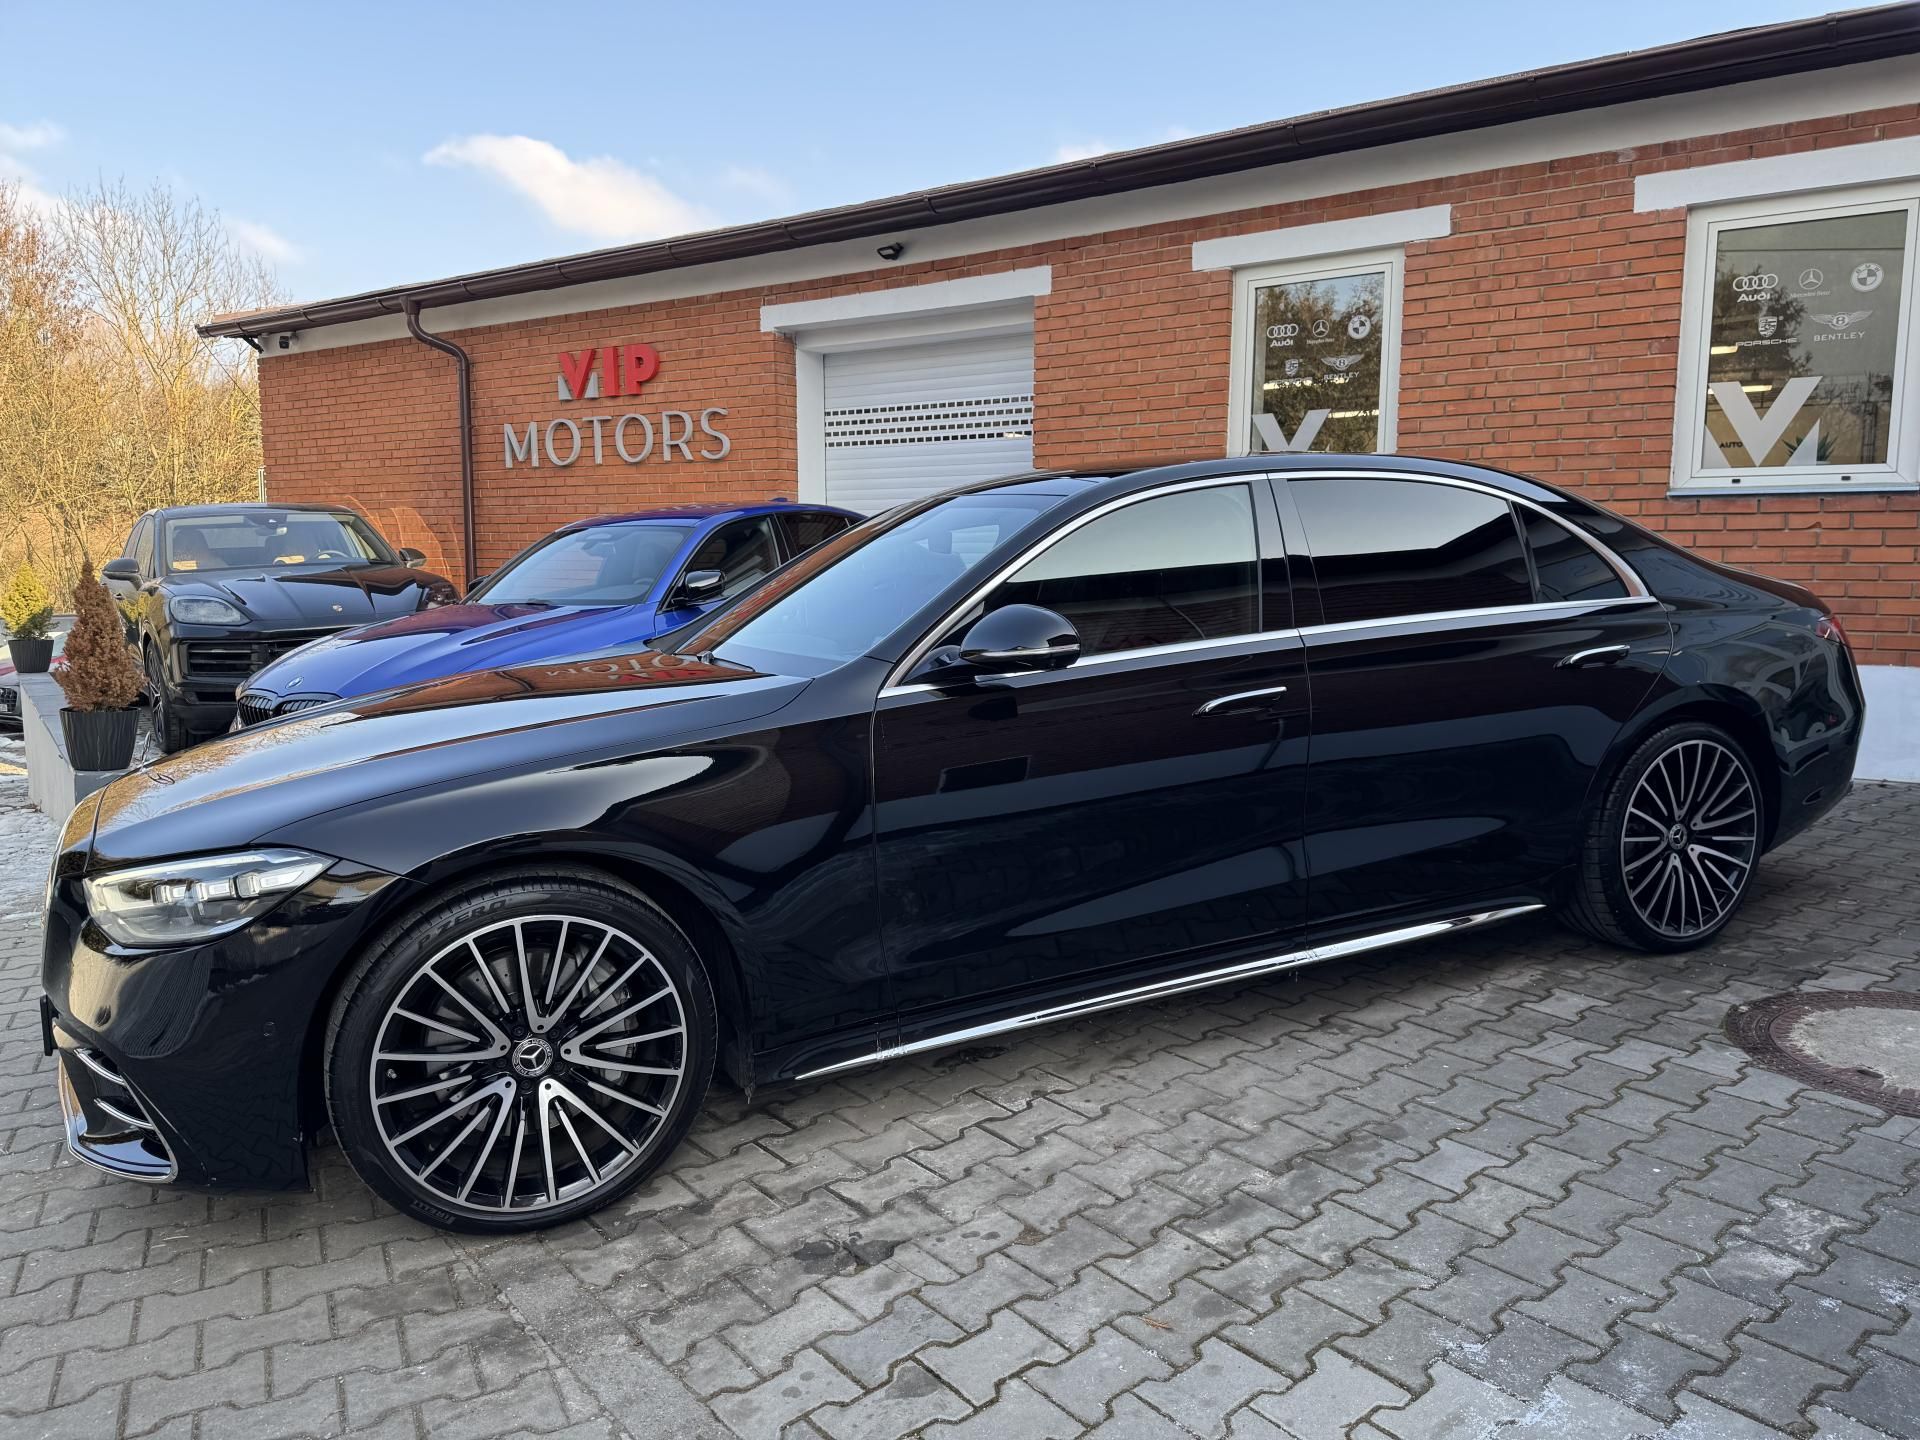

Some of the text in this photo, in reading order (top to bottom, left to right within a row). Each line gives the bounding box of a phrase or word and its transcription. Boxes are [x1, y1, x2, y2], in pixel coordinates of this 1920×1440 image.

[1737, 291, 1770, 302] Audi
[1736, 337, 1799, 347] PORSCHE
[1813, 331, 1866, 342] BENTLEY
[1270, 338, 1294, 348] Audi
[558, 343, 660, 400] VIP
[504, 407, 731, 469] MOTORS
[1719, 441, 1743, 449] AUTO
[417, 899, 508, 951] P ZERO
